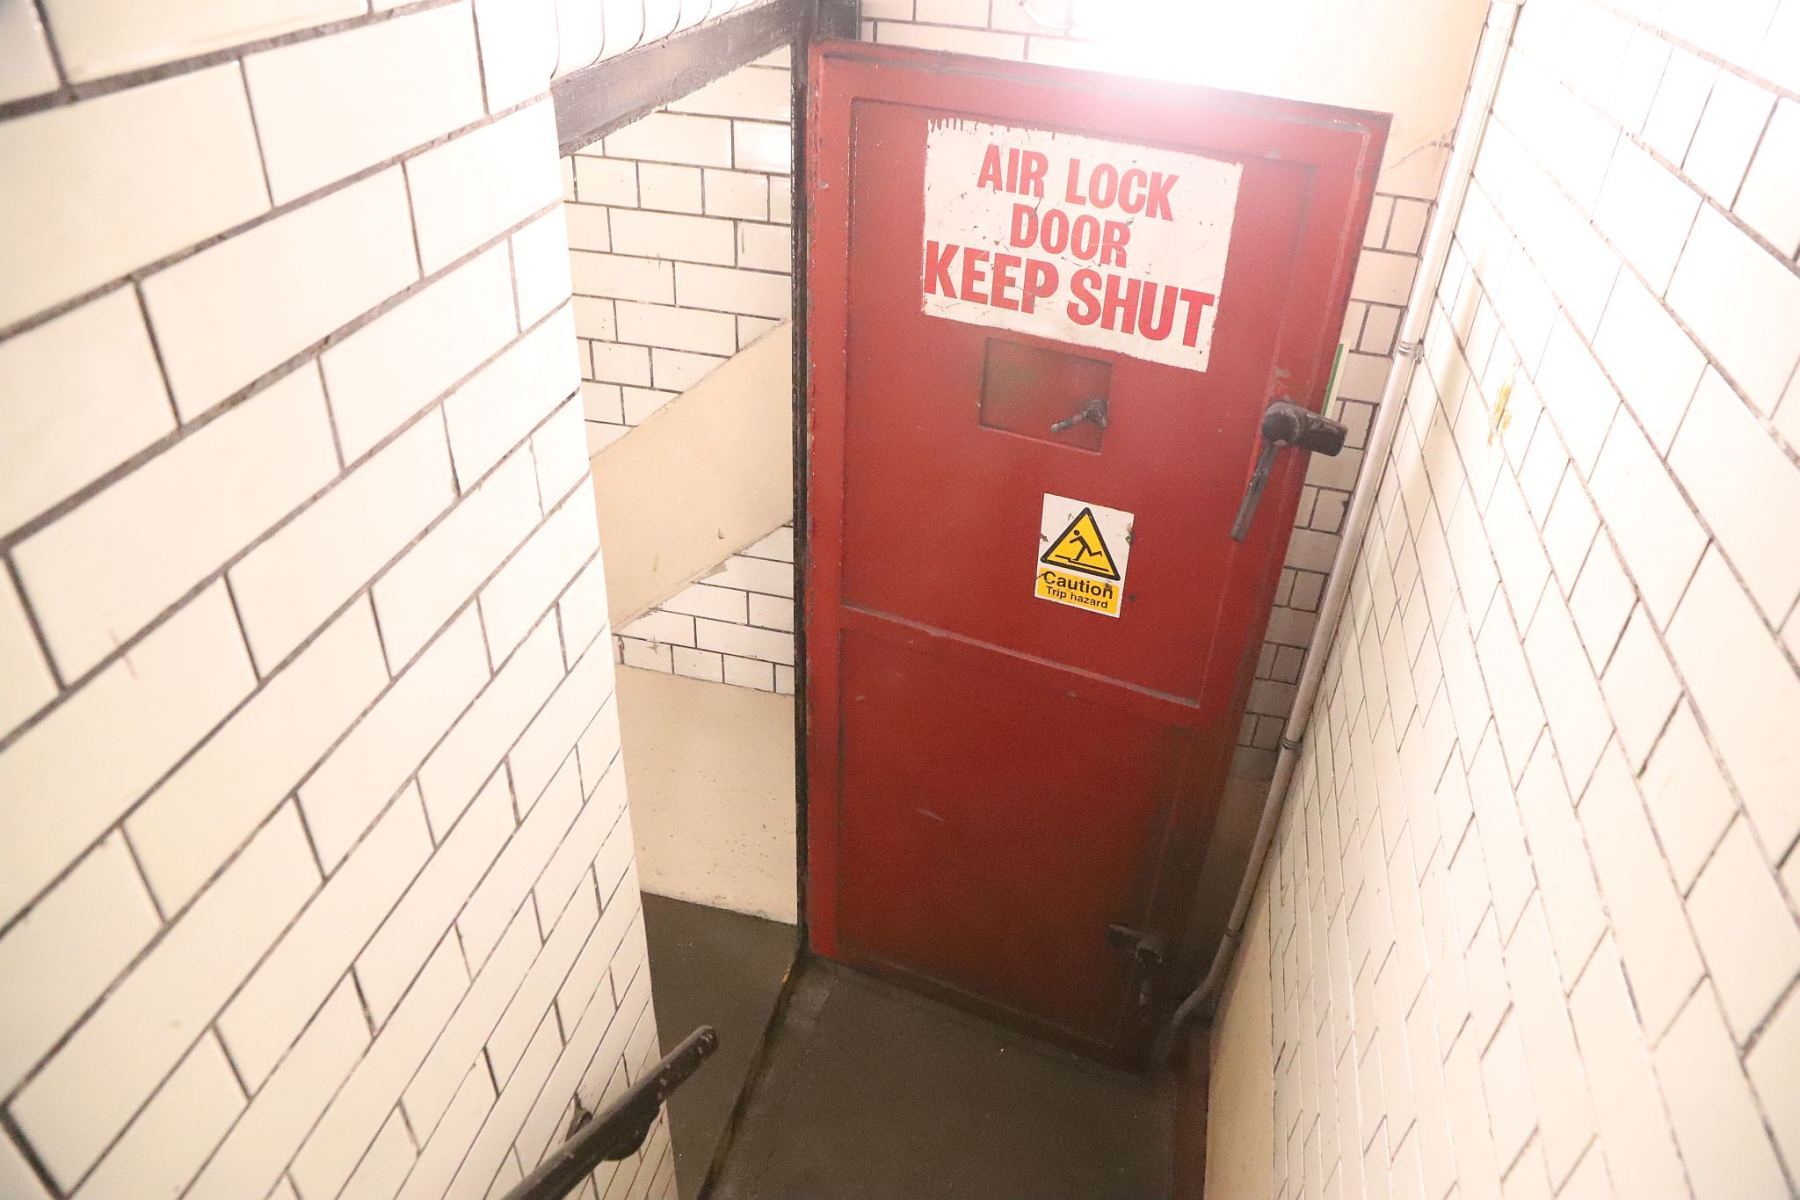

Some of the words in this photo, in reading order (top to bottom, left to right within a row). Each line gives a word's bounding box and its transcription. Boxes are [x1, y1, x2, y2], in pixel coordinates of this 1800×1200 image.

[976, 143, 1049, 199] AIR
[1064, 157, 1180, 222] LOCK
[1009, 202, 1131, 268] DOOR
[923, 239, 1060, 315] KEEP
[1066, 268, 1215, 348] SHUT
[1043, 570, 1113, 599] Caution
[1046, 585, 1067, 600] Trip
[1070, 590, 1108, 608] hazard
